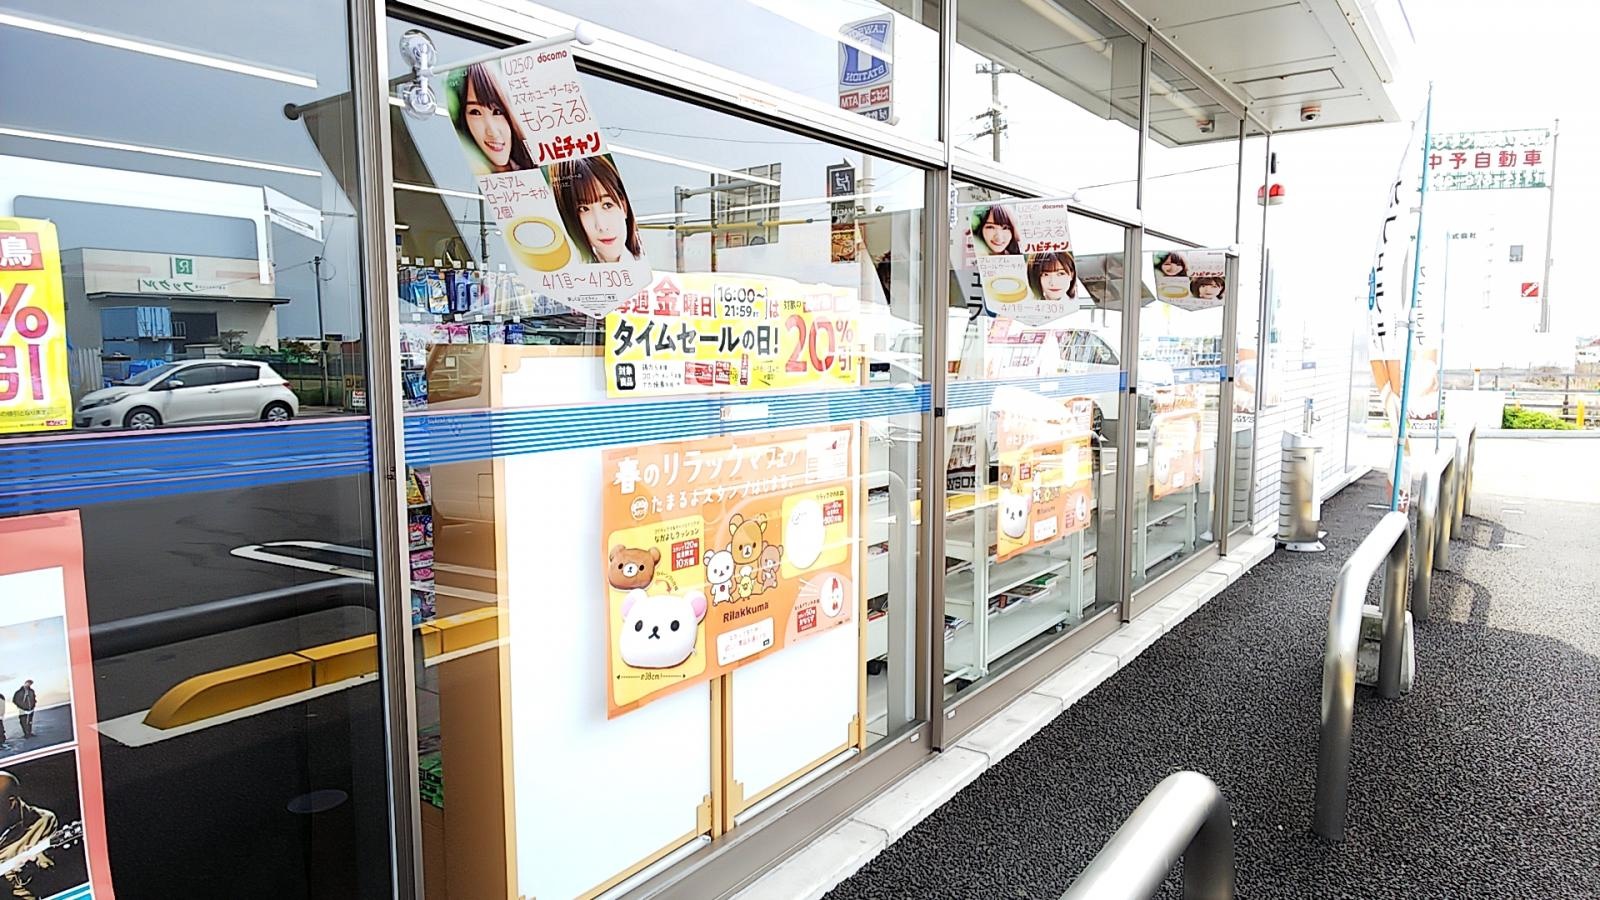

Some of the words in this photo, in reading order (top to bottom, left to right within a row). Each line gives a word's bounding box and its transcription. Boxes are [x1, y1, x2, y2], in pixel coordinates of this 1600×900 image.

[504, 54, 534, 76] U25の
[536, 49, 567, 64] docomo
[509, 78, 529, 90] ドコモ
[513, 81, 580, 105] スマホユーザーなら
[539, 132, 601, 162] ハピチャン
[1429, 149, 1542, 171] 中予自動車
[480, 177, 525, 191] プレミアム
[487, 186, 548, 205] ロールケーキが
[1025, 241, 1069, 252] ハピチャン
[613, 319, 779, 357] タイムセールの日!
[612, 444, 800, 495] 春のリラックマフェア
[654, 528, 699, 543] なかよしクッション
[723, 601, 769, 623] Rilakkuma
